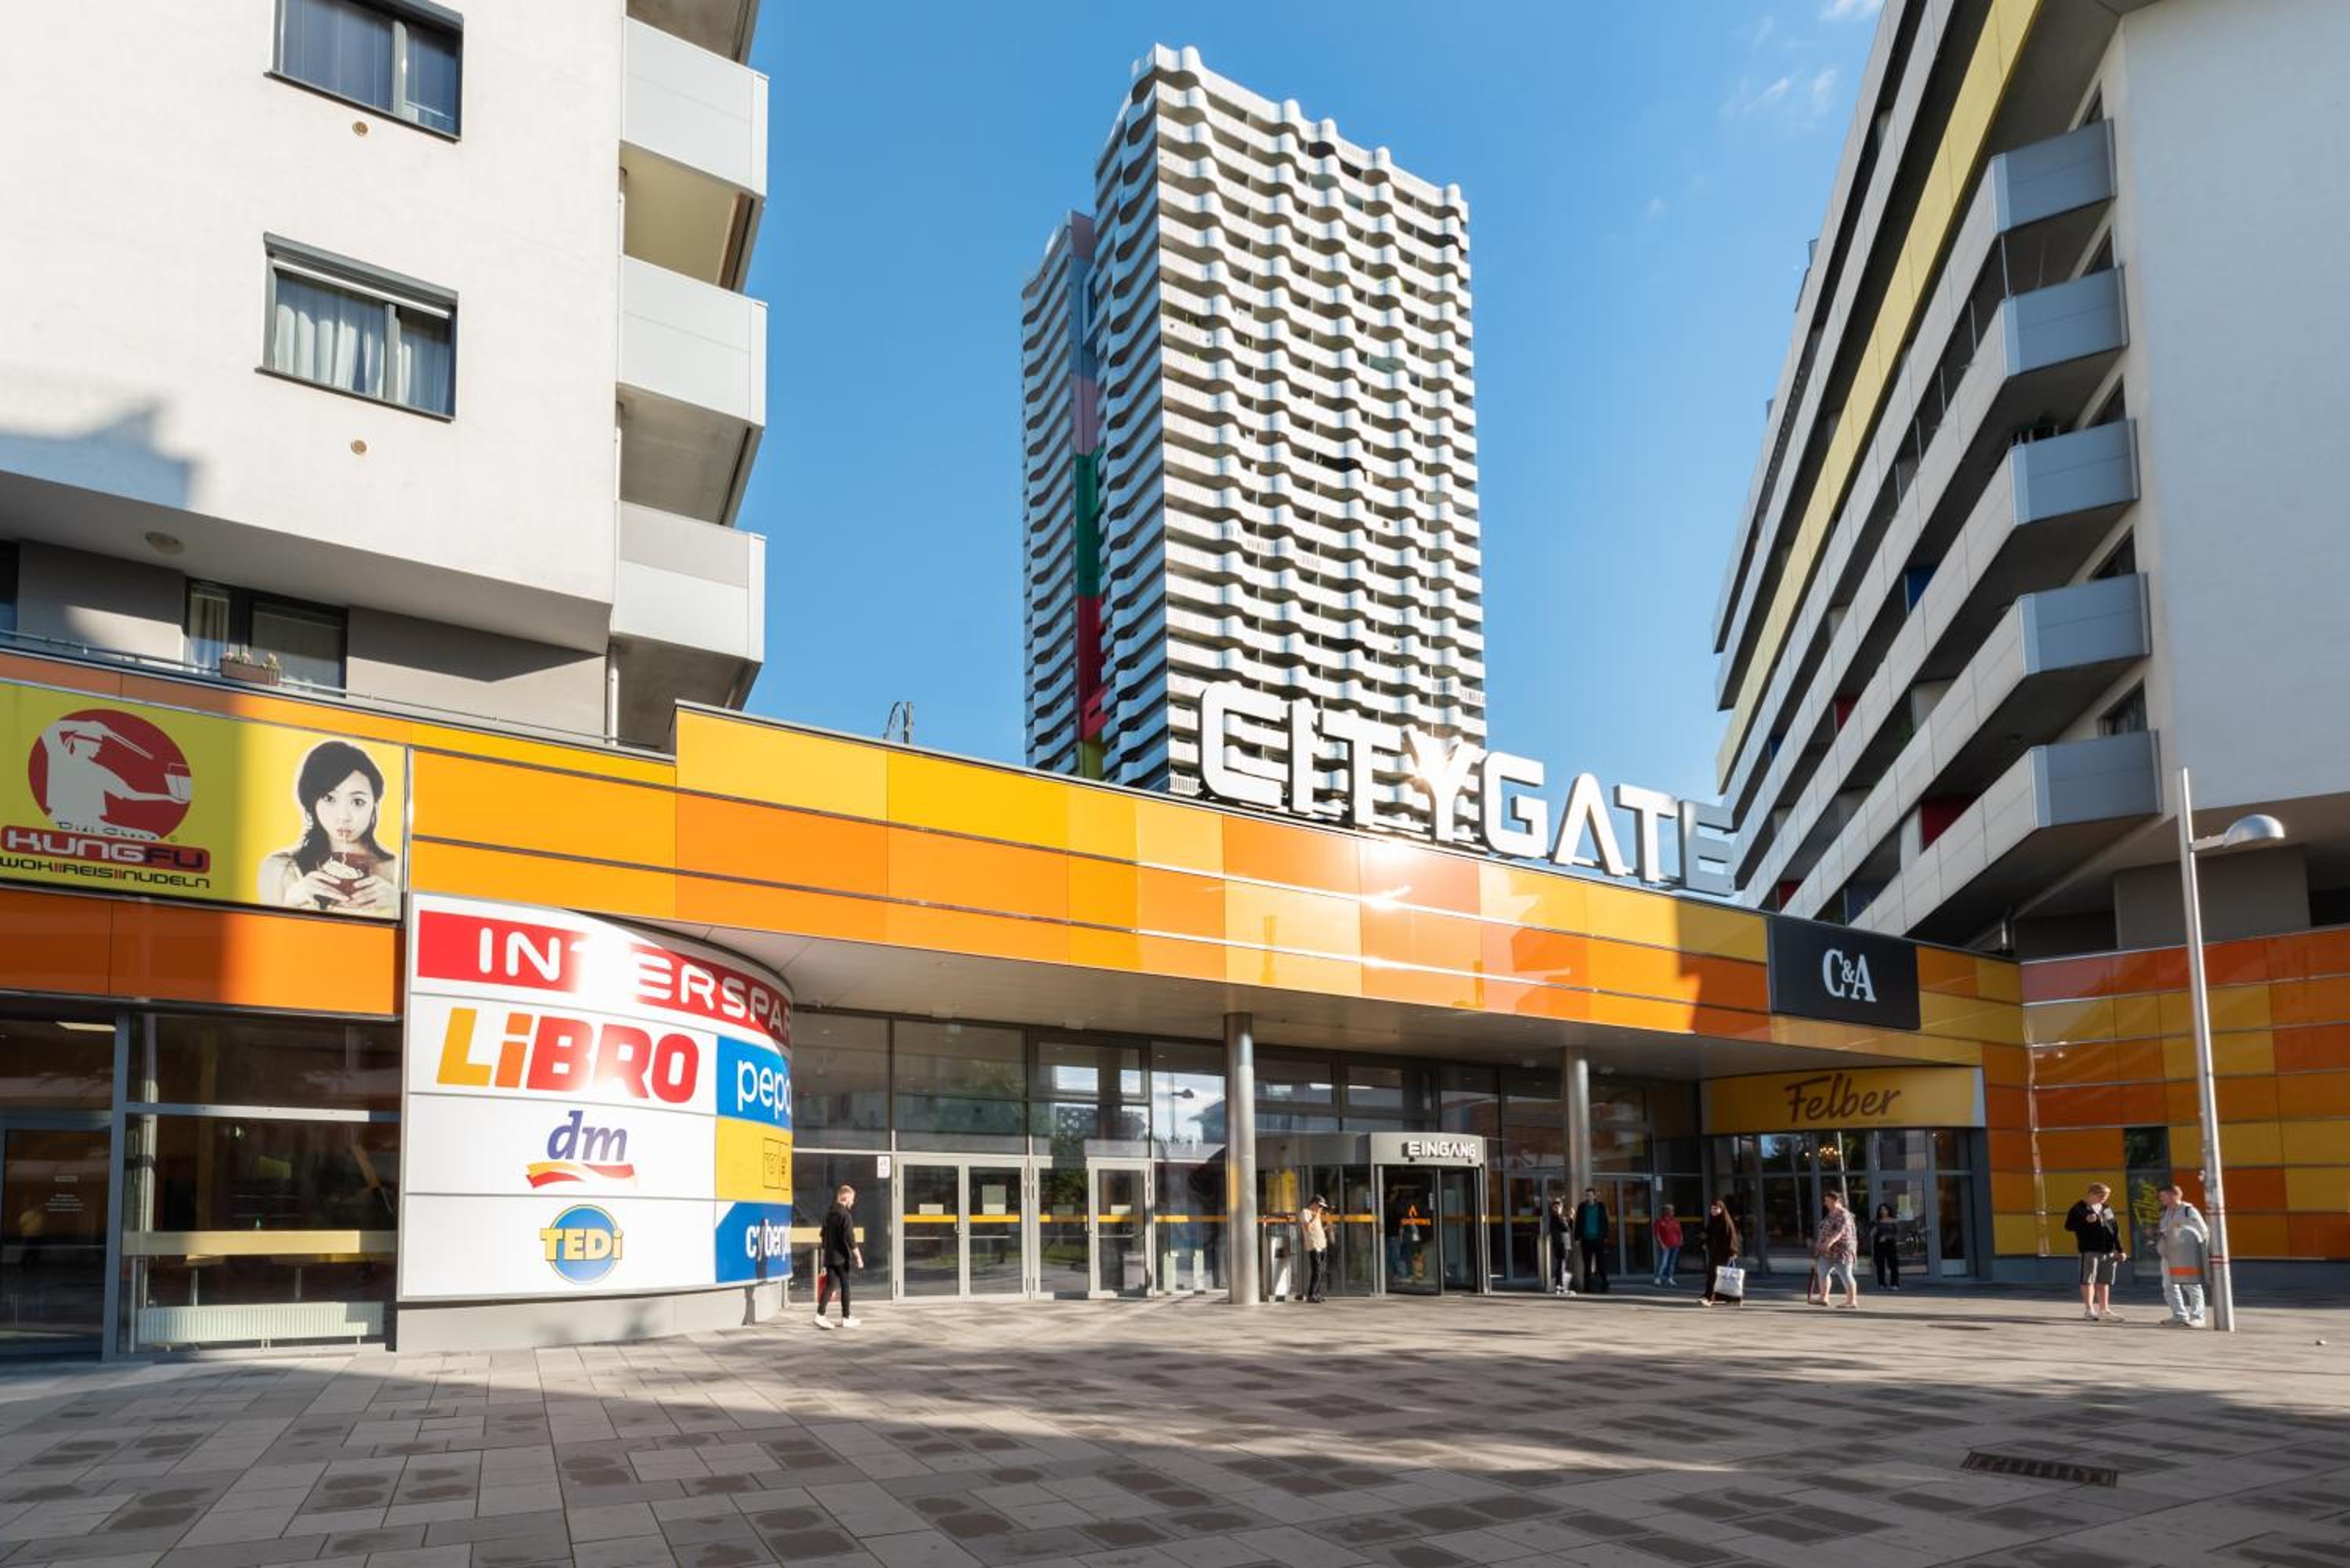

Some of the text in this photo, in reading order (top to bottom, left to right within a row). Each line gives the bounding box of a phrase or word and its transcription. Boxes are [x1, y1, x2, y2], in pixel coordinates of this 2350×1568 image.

[1199, 680, 1734, 898] CITYGATE
[479, 927, 790, 1039] INERSPAR
[1823, 948, 1877, 1003] C&A
[1784, 1073, 1902, 1123] Felber
[547, 1110, 627, 1162] dm
[1408, 1141, 1477, 1157] EINGANG
[540, 1227, 624, 1261] TEDi
